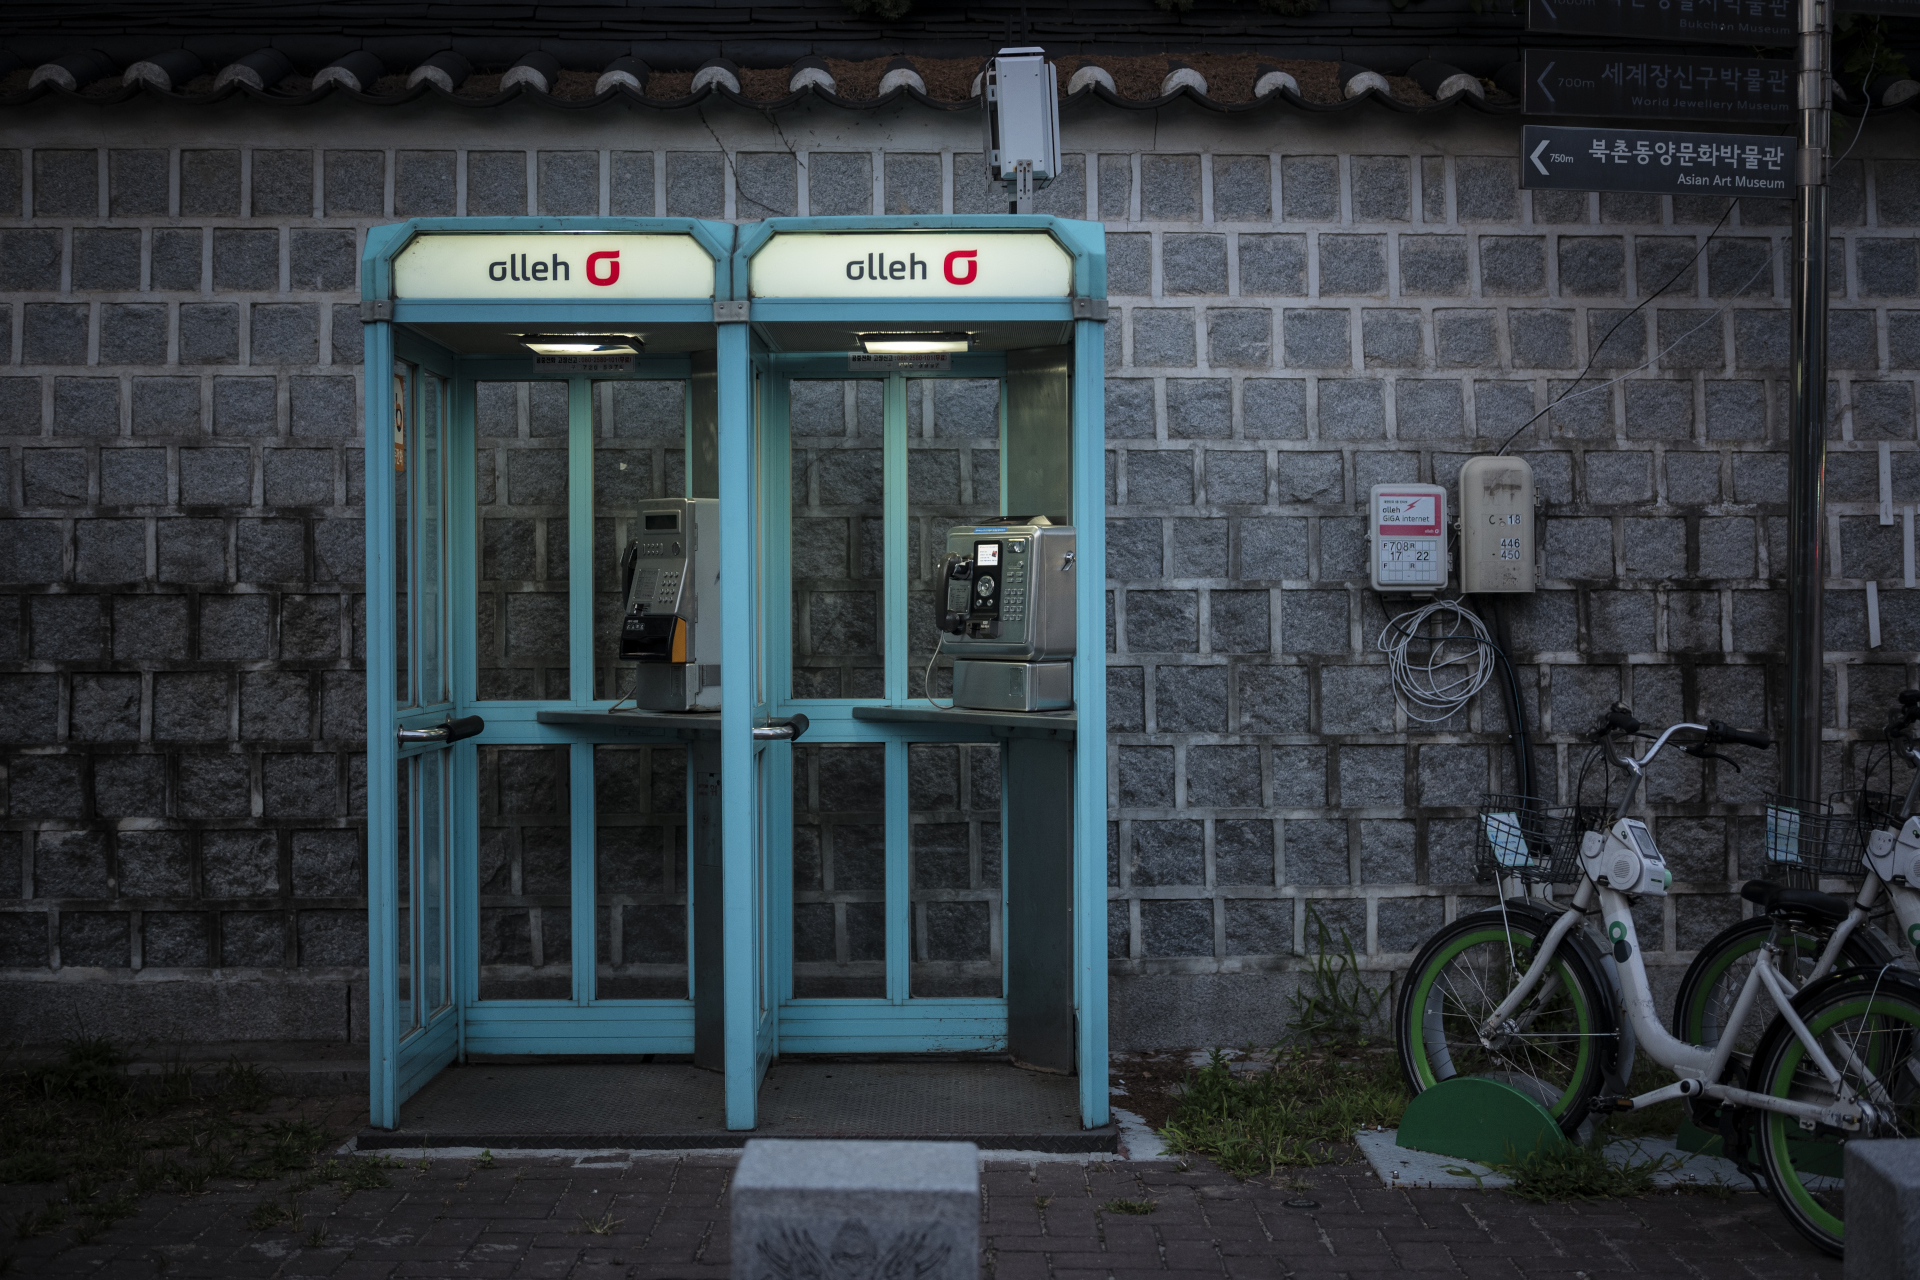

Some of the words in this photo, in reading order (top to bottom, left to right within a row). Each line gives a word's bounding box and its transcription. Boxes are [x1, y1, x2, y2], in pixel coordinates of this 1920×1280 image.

[1679, 18, 1734, 31] Bukchon
[1738, 22, 1791, 35] Museum
[1557, 77, 1595, 89] 700m
[1601, 63, 1789, 93] 세계장신구박물관
[1631, 96, 1670, 107] World
[1673, 97, 1734, 111] Jewellery
[1737, 100, 1790, 111] Museum
[1549, 153, 1574, 164] 750m
[1588, 139, 1784, 171] 북촌동양문화박물관
[1677, 173, 1710, 186] Asian
[1713, 174, 1732, 187] Art
[1735, 176, 1785, 189] Museum
[489, 253, 570, 281] olleh
[846, 252, 927, 280] olleh
[1382, 506, 1401, 514] olleh
[1402, 515, 1430, 523] internet
[1389, 541, 1409, 551] 708
[1501, 538, 1520, 549] 446
[1416, 551, 1429, 561] 22
[1501, 549, 1520, 560] 450
